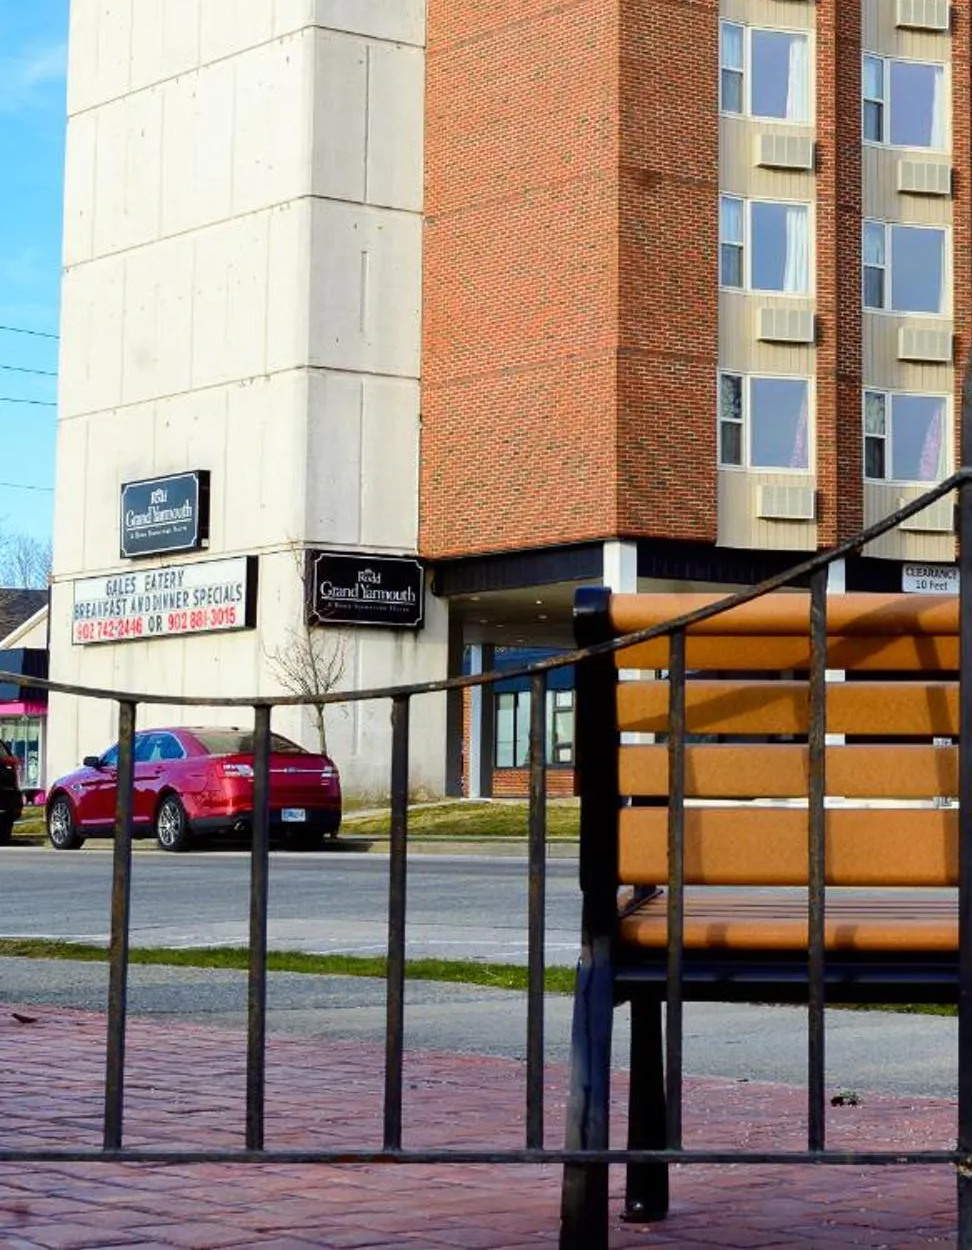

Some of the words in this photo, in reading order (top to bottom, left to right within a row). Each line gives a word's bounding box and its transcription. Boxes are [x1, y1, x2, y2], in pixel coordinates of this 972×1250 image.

[126, 506, 151, 527] Grand
[152, 500, 192, 523] Yarmouth
[106, 577, 136, 596] GALES
[144, 570, 184, 591] EATERY
[321, 581, 359, 599] Grand
[360, 583, 416, 602] Yarmouth
[75, 599, 127, 620] BREAKFAST
[152, 591, 188, 611] DINNER
[193, 584, 242, 606] SPECIALS
[148, 616, 162, 632] OR
[168, 611, 187, 631] 902
